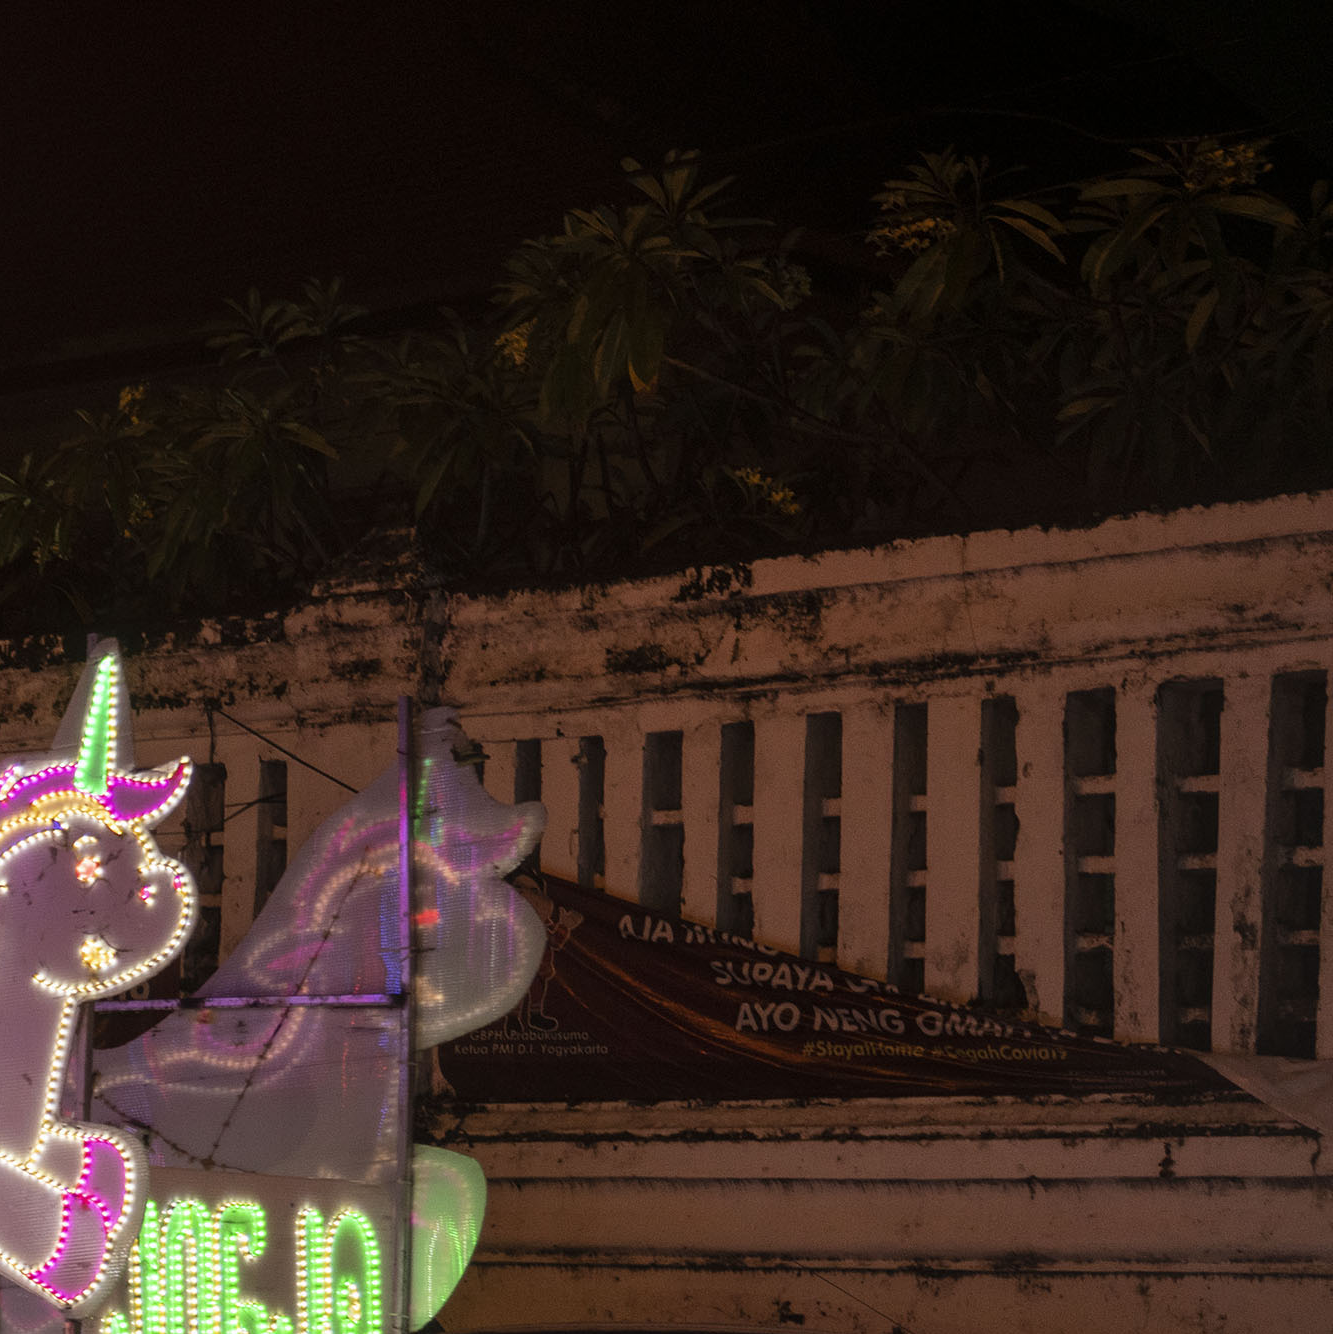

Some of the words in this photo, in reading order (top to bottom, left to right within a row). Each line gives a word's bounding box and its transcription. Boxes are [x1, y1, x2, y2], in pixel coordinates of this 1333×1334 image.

[710, 959, 834, 991] SUPAYA
[735, 1001, 801, 1032] AYO
[812, 1003, 906, 1035] NENG
